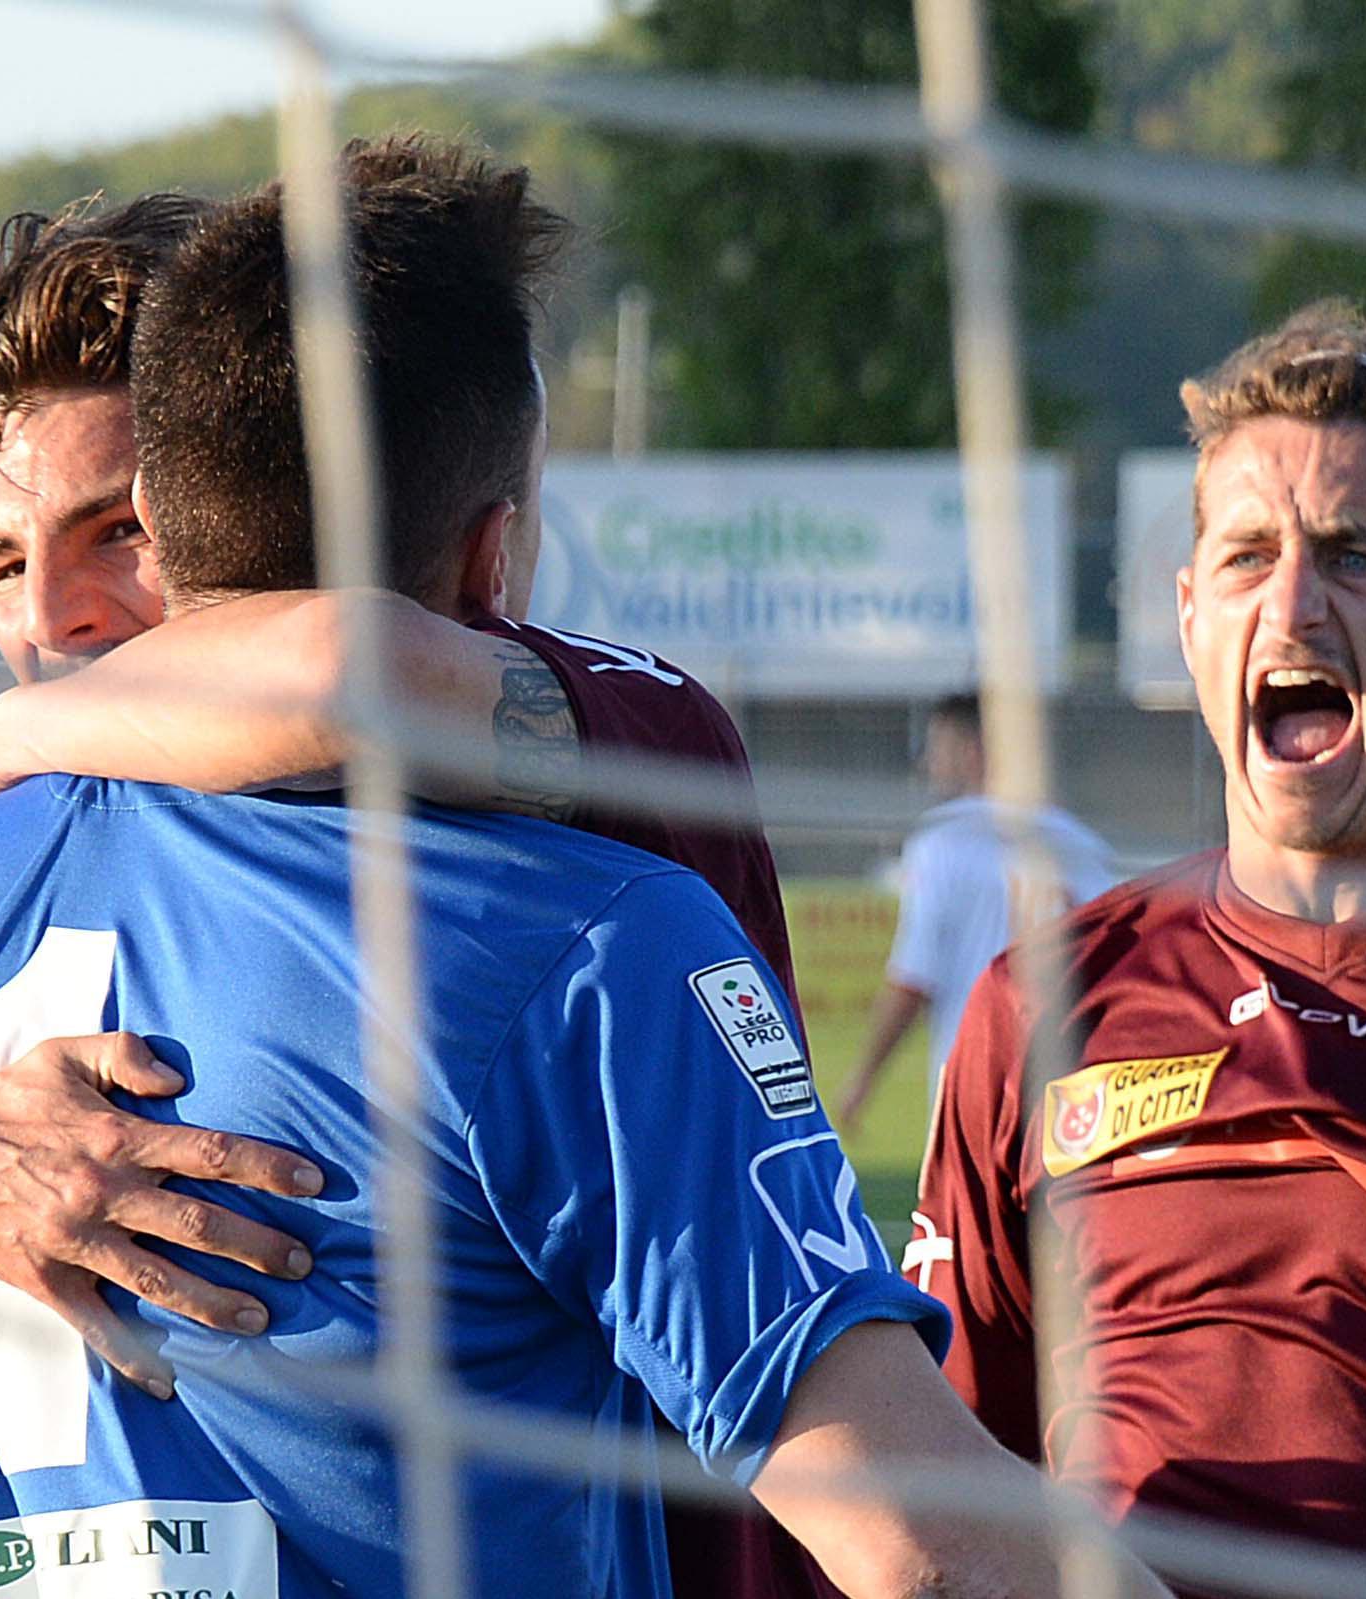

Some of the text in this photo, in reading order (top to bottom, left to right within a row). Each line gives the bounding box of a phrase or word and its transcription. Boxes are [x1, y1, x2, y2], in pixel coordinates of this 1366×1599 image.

[733, 1012, 777, 1030] LEGA
[743, 1025, 785, 1048] PRO
[1111, 1100, 1134, 1139] DI
